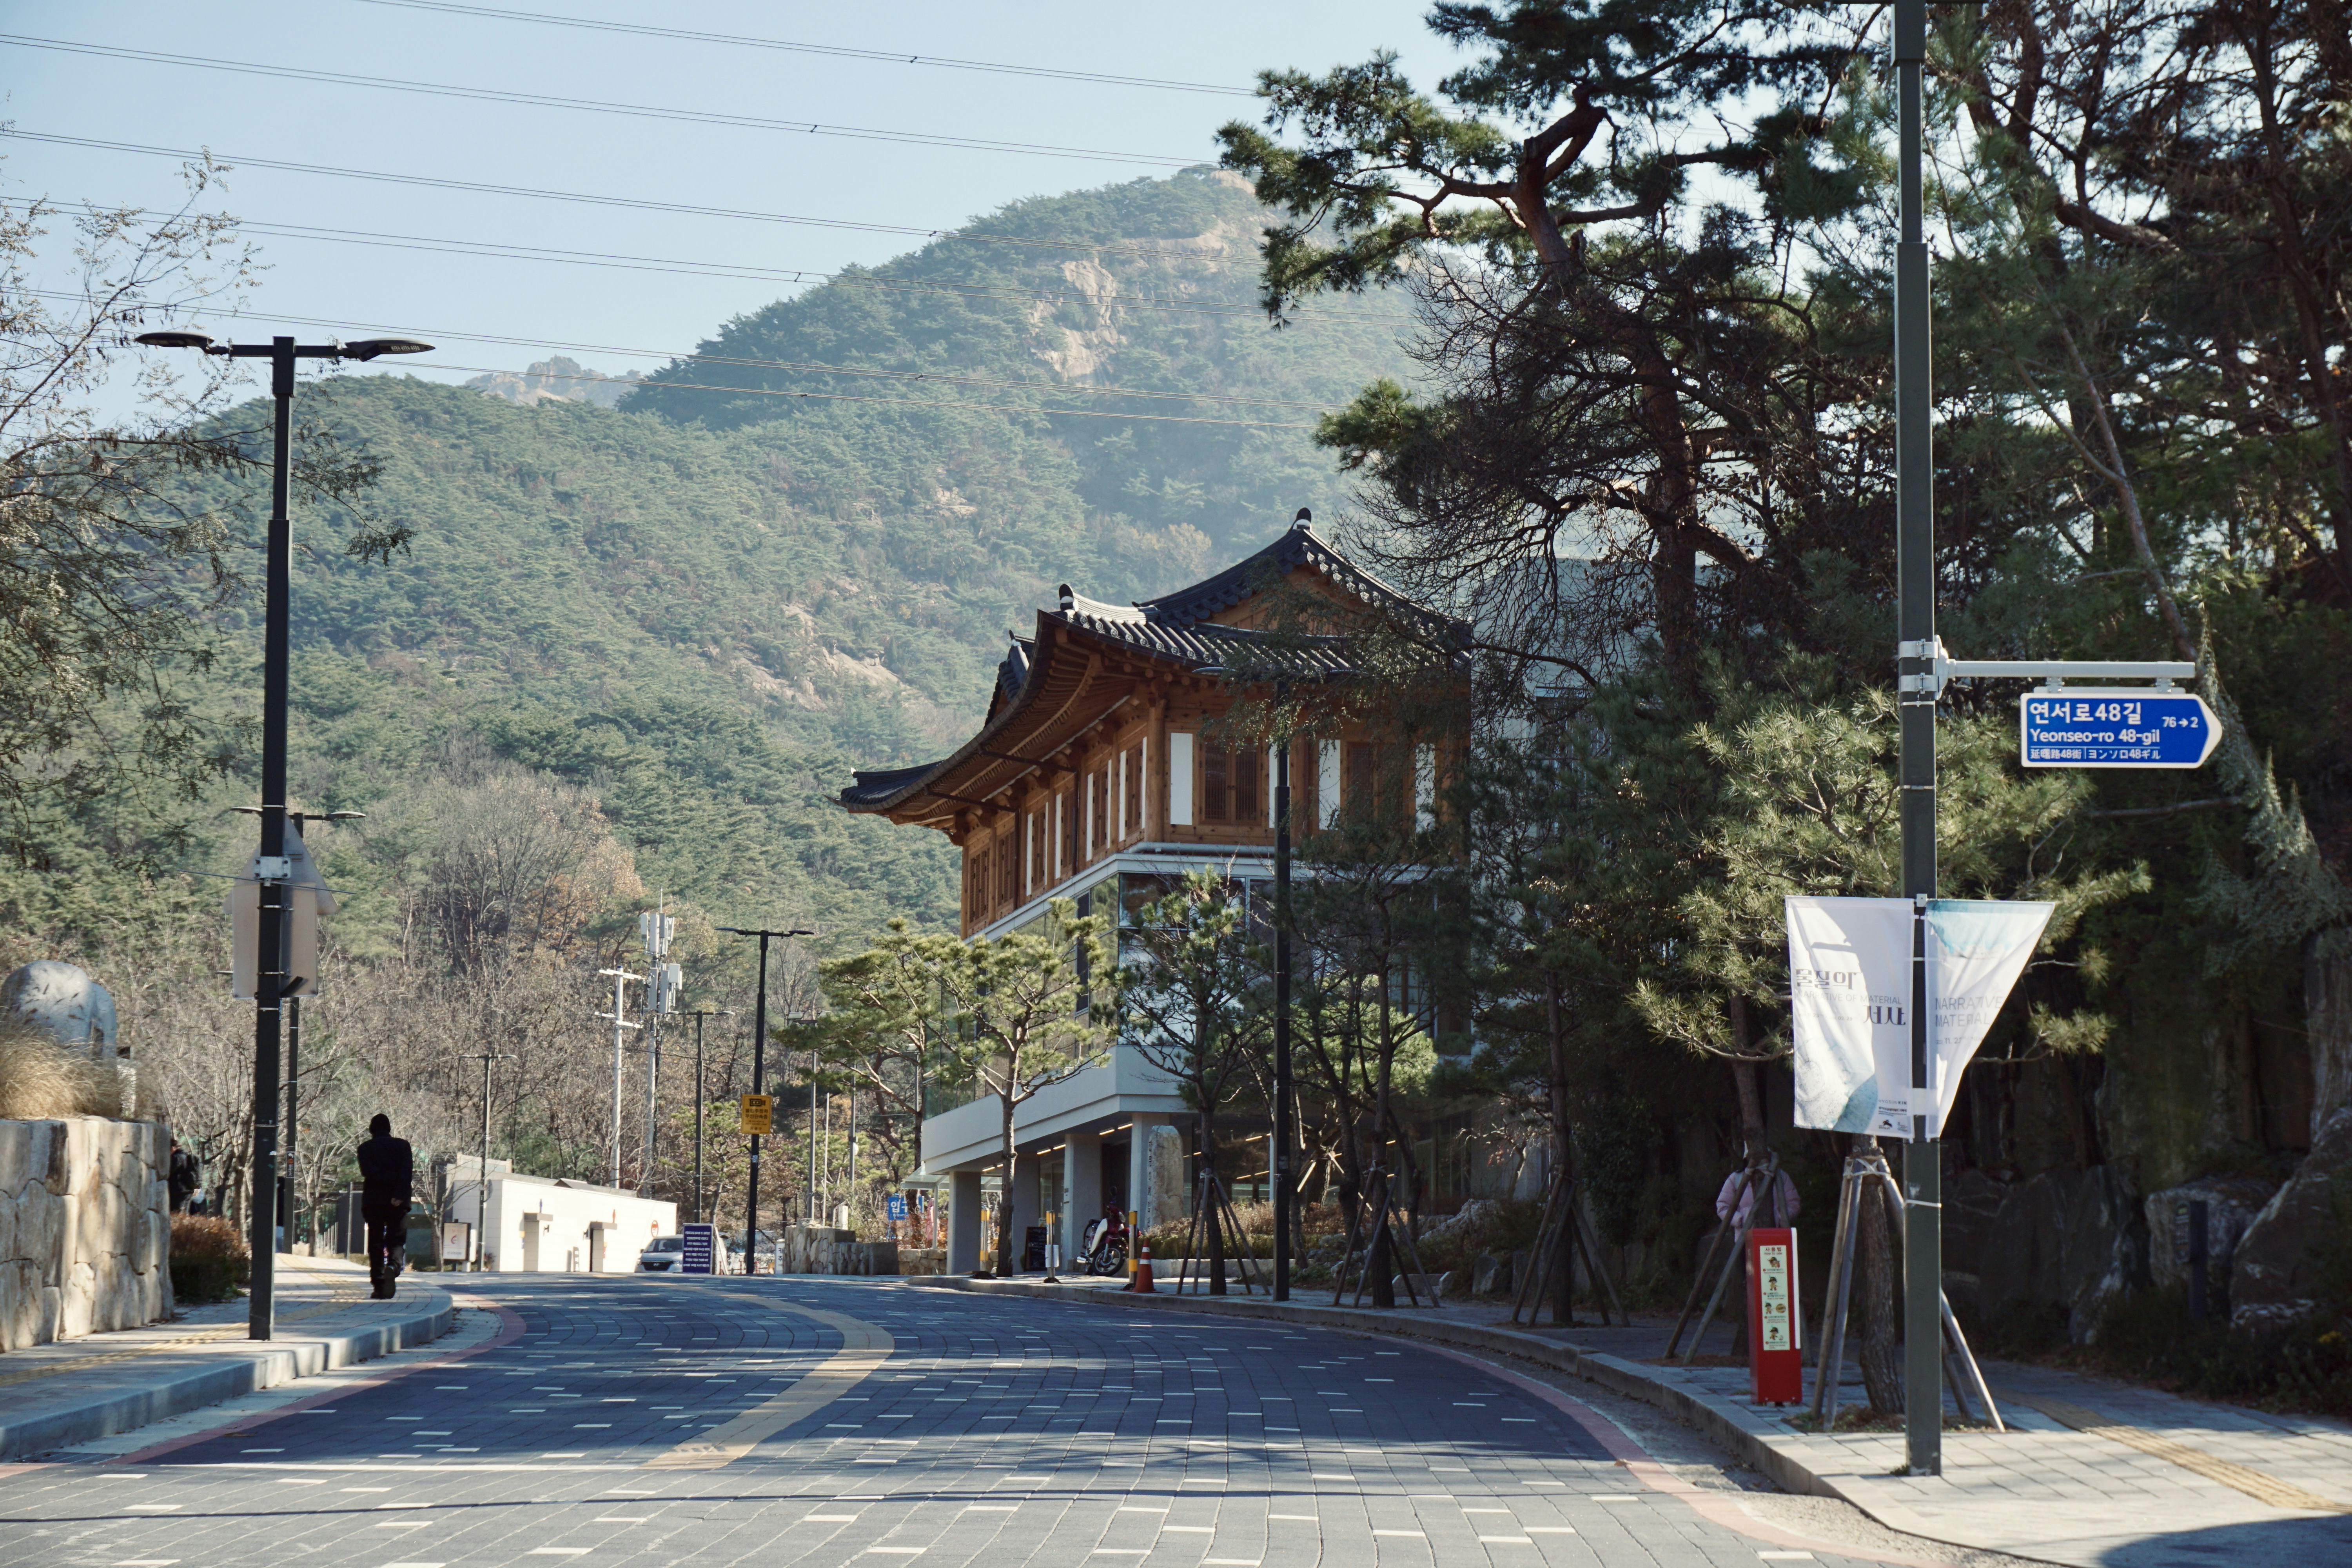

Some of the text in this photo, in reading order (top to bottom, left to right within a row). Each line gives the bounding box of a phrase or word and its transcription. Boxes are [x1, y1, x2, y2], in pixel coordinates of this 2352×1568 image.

[2030, 702, 2141, 725] 연서로48길
[2162, 717, 2198, 728] 76 2
[2031, 729, 2160, 746] Yeonseo-ro 48-gil
[2088, 749, 2161, 759] ヨンソロ48ギル
[1860, 995, 1902, 1004] MATERIAL
[1935, 996, 2002, 1010] NARRATIVE
[1863, 1005, 1906, 1025] 서사
